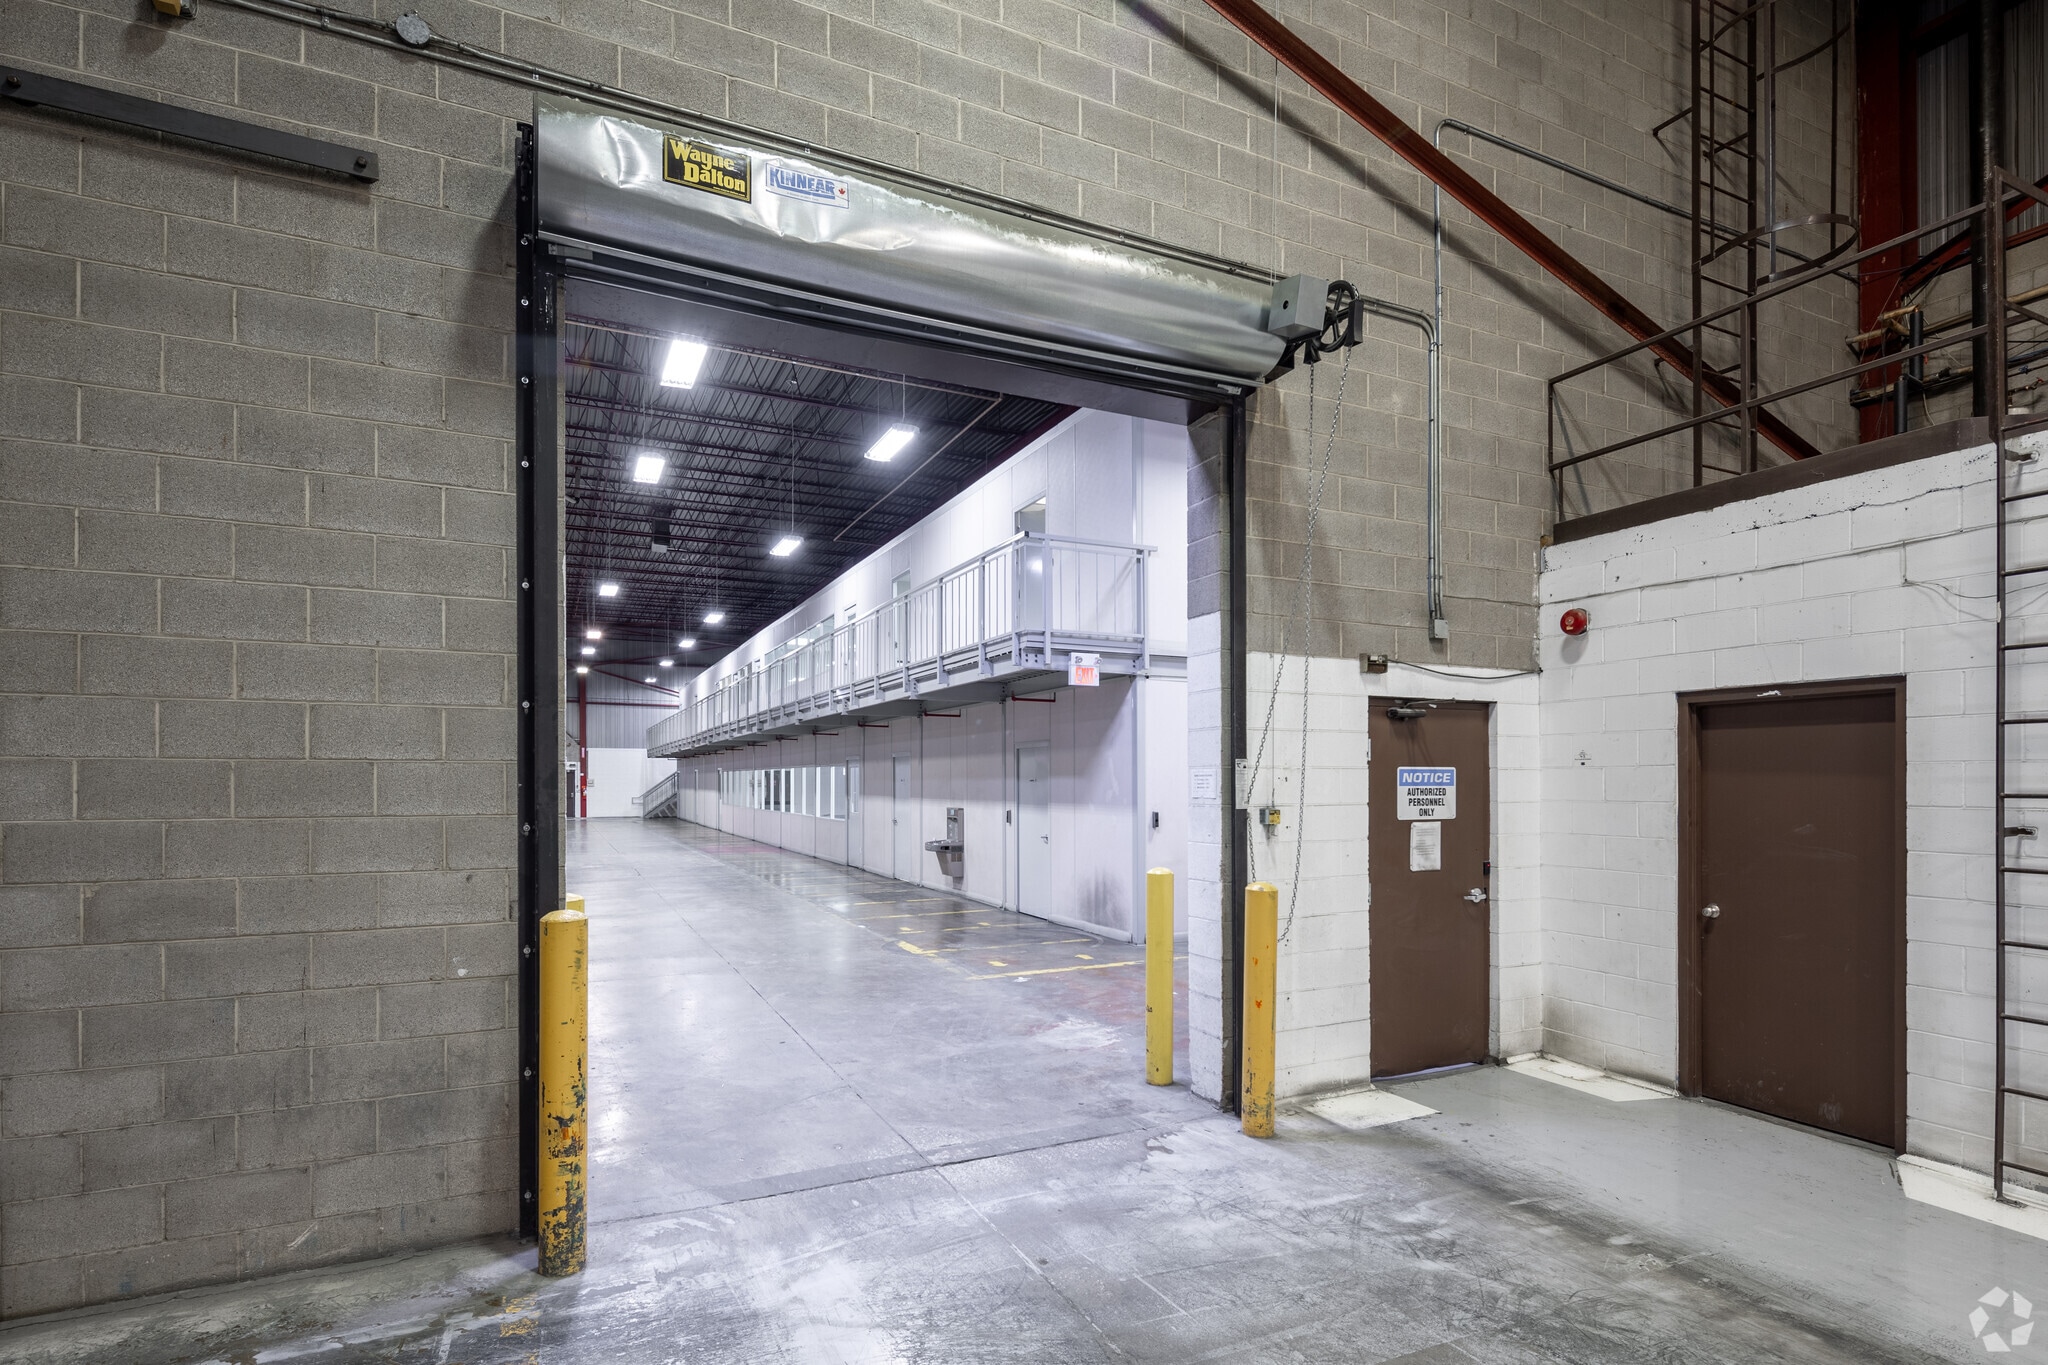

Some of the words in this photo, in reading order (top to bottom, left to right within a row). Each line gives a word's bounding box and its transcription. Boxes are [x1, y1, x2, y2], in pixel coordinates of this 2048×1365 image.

[669, 139, 735, 171] Wayne
[683, 161, 746, 193] Dalton
[769, 166, 836, 199] KINNEAR
[1075, 667, 1095, 684] EXIT
[1402, 772, 1452, 783] NOTICE
[1407, 787, 1447, 797] AUTHORIZED
[1408, 797, 1446, 807] PERSONNEL
[1418, 807, 1435, 817] ONLY
